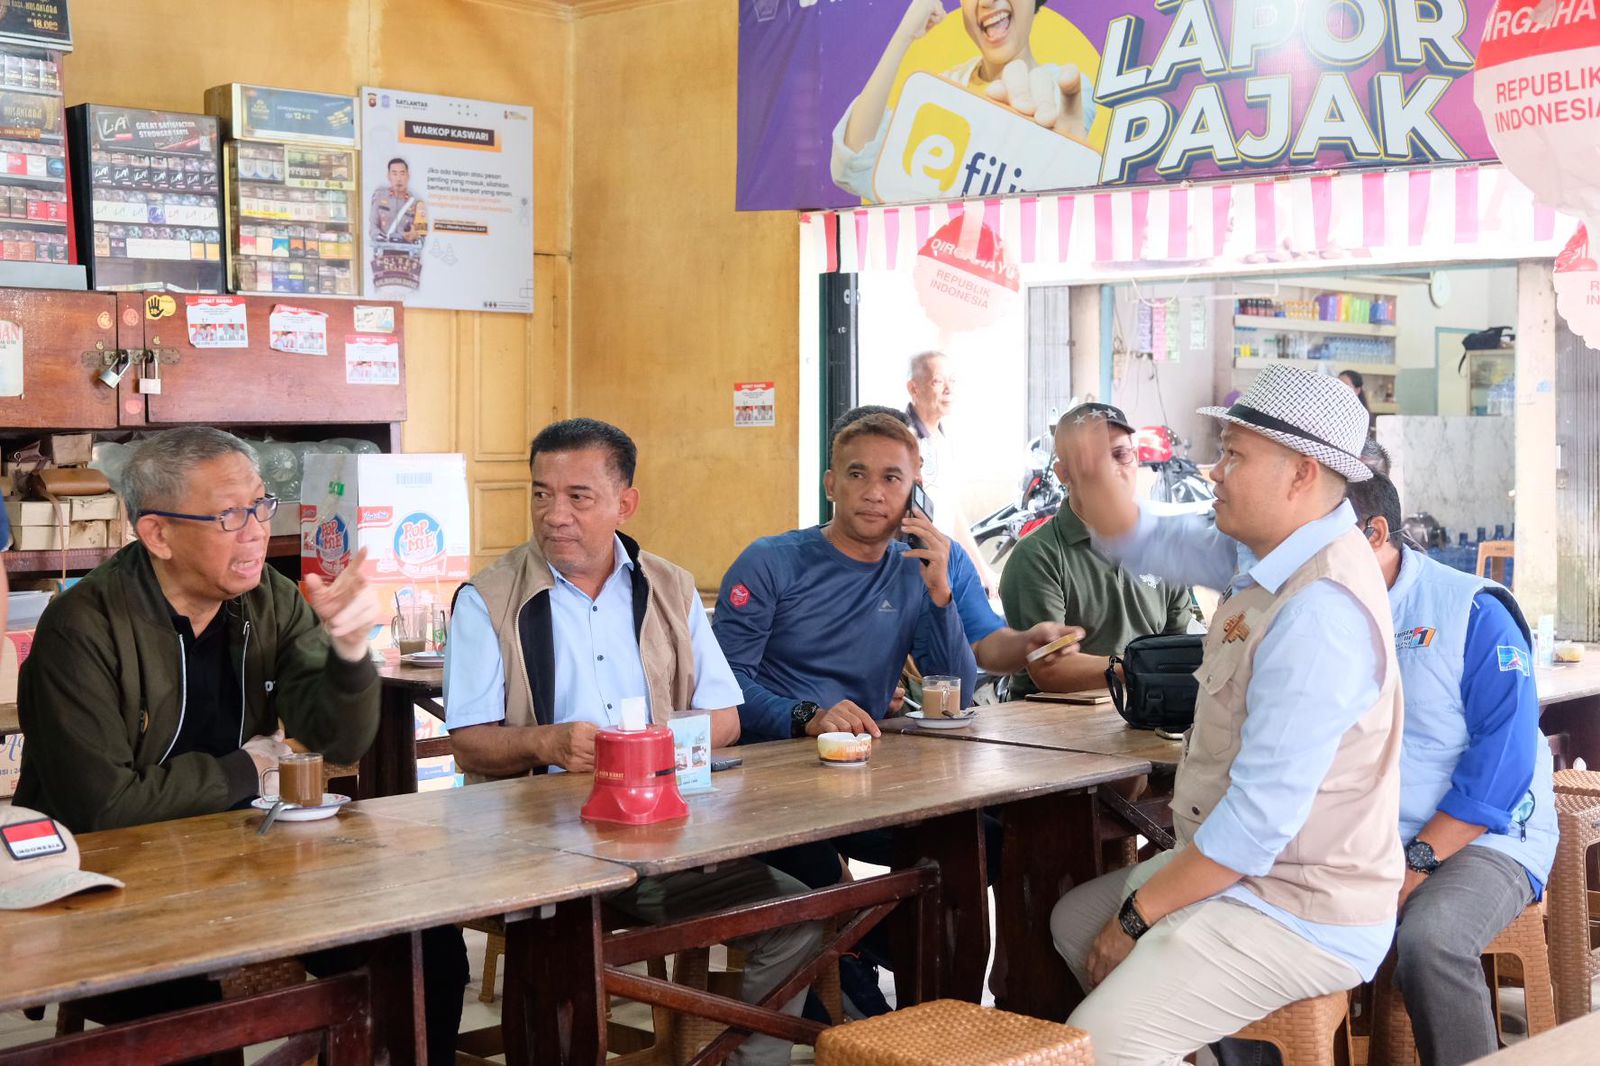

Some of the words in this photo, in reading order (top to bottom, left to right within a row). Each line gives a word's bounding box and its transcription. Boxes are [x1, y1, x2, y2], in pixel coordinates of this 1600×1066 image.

[1095, 0, 1473, 101] LAPOR
[1496, 66, 1600, 104] REPUBLIK
[412, 125, 450, 137] WARKOP
[450, 129, 489, 141] KASWARI
[1099, 72, 1469, 185] PAJAK
[960, 152, 1027, 197] fili
[929, 279, 989, 310] INDONESIA
[936, 269, 991, 298] REPUBLIK
[403, 520, 428, 540] POP
